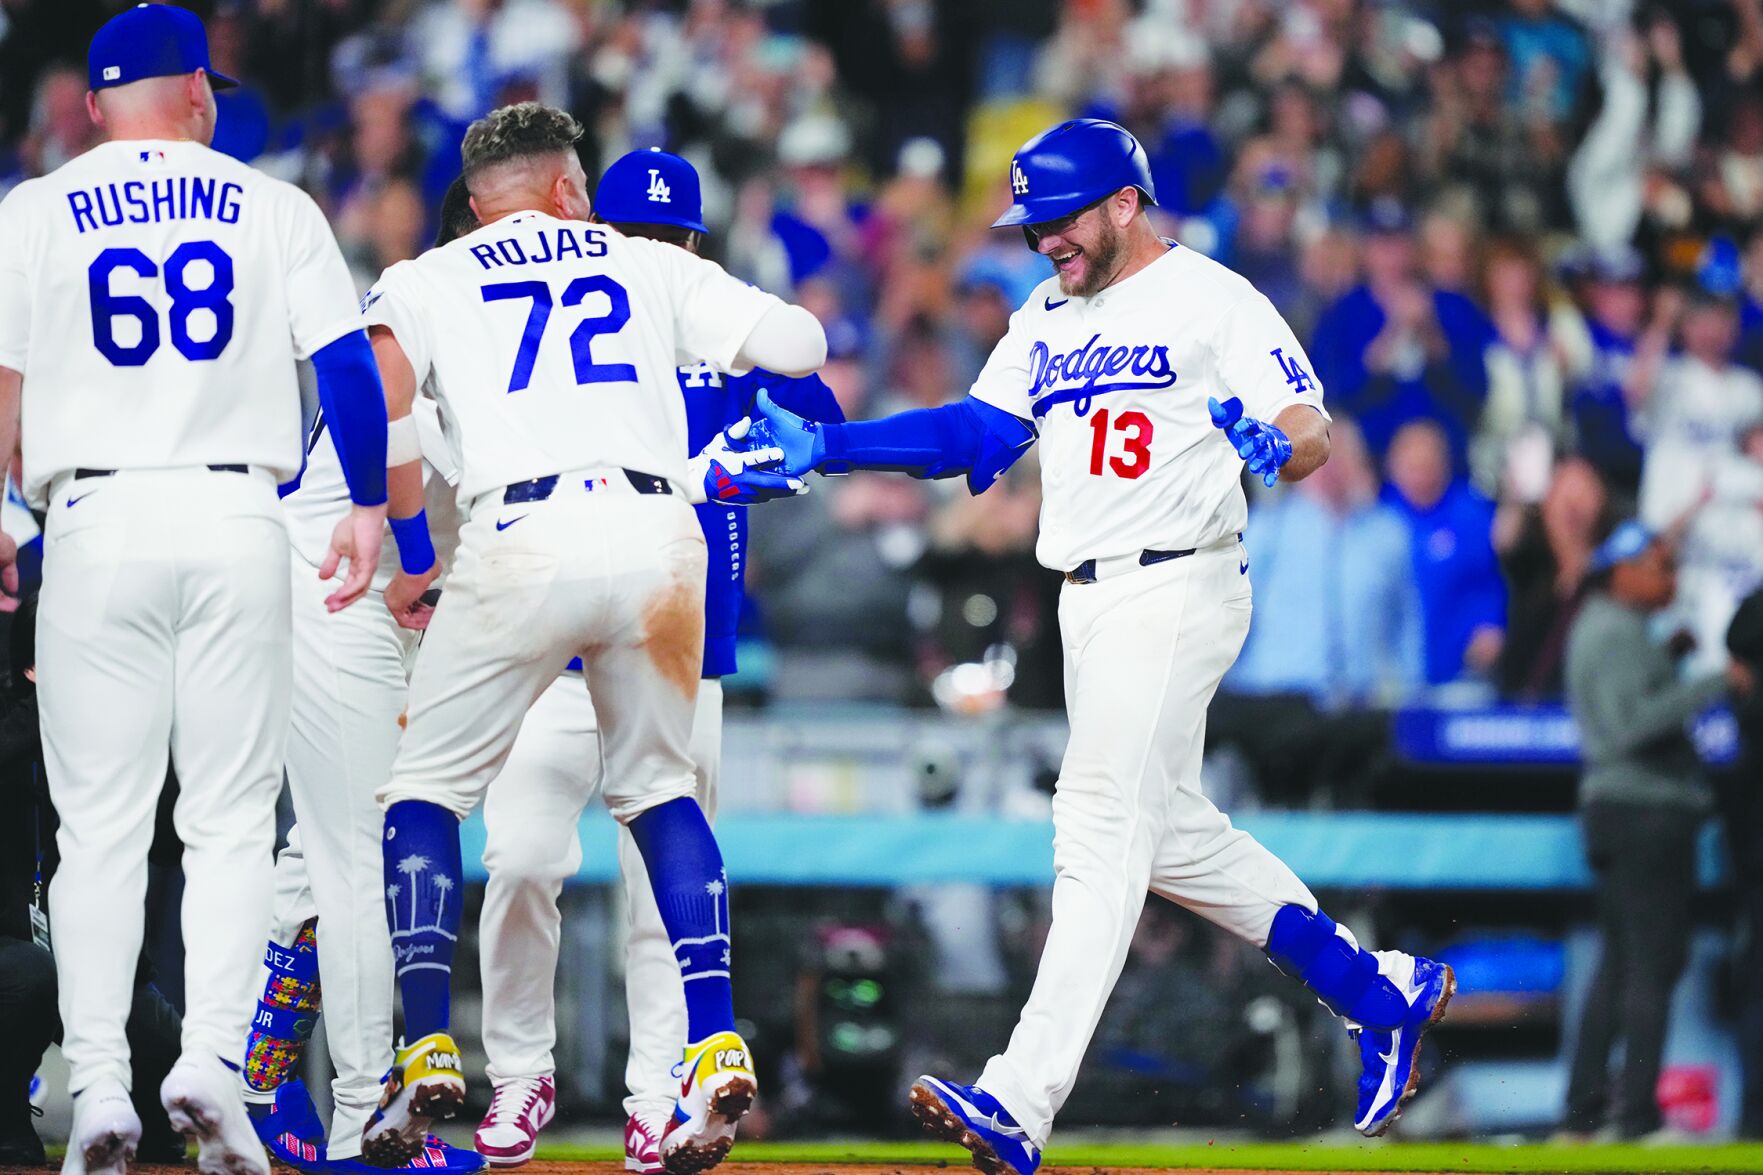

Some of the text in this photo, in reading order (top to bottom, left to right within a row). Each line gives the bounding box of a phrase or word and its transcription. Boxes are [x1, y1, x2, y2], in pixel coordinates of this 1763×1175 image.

[647, 168, 671, 203] LA
[1012, 159, 1029, 195] LA
[67, 177, 243, 234] RUSHING
[469, 228, 608, 270] ROJAS
[88, 240, 234, 367] 68
[480, 274, 639, 394] 72
[1028, 333, 1178, 420] Dodgers
[1270, 347, 1316, 394] LA
[1090, 407, 1154, 480] 13
[255, 1009, 274, 1028] JR
